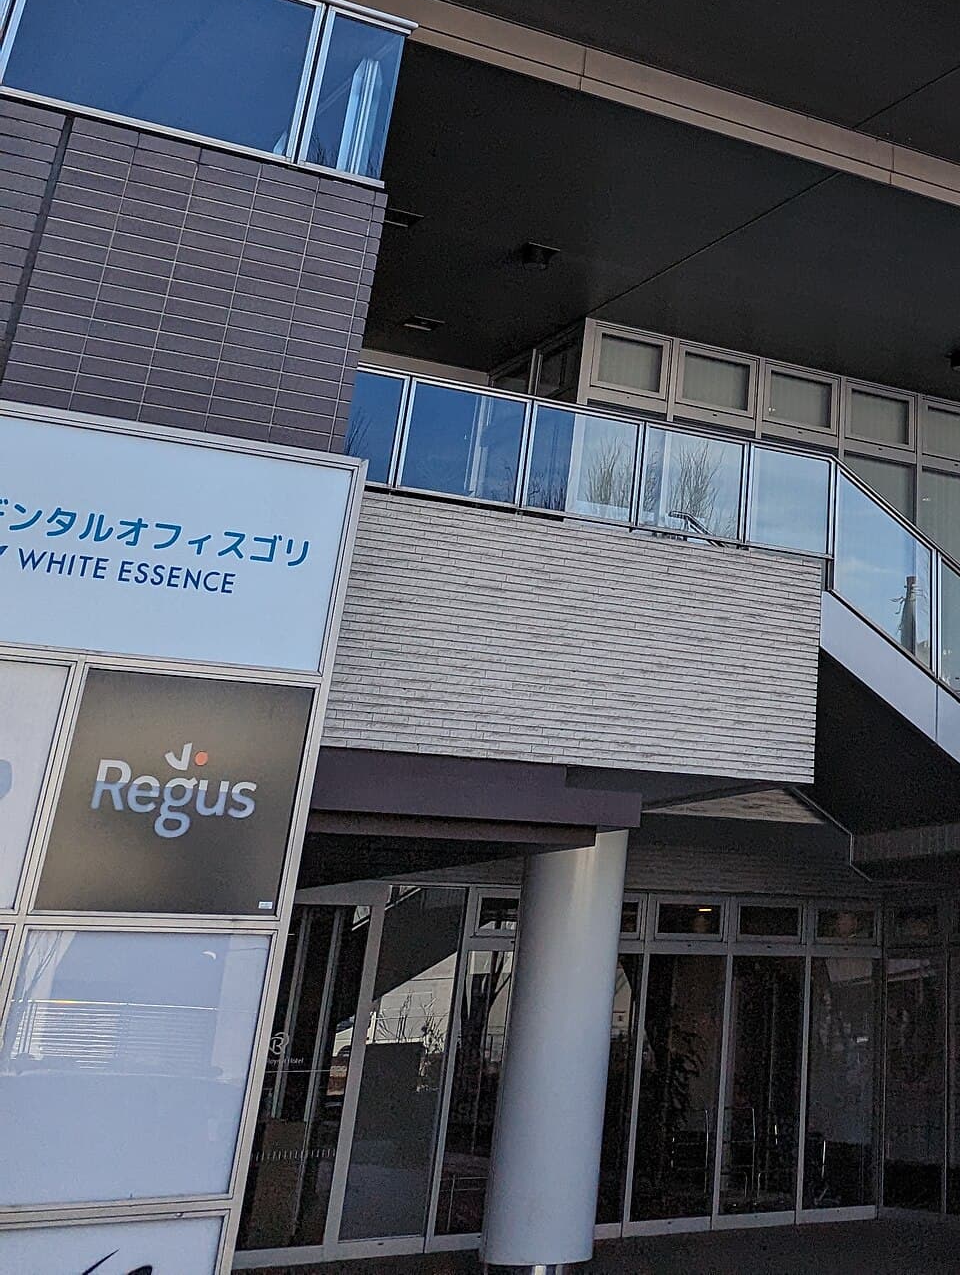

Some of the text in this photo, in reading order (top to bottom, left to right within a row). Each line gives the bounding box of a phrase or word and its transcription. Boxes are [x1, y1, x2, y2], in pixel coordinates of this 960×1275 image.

[18, 547, 236, 594] WHITE ESSENCE
[91, 758, 257, 838] Regus
